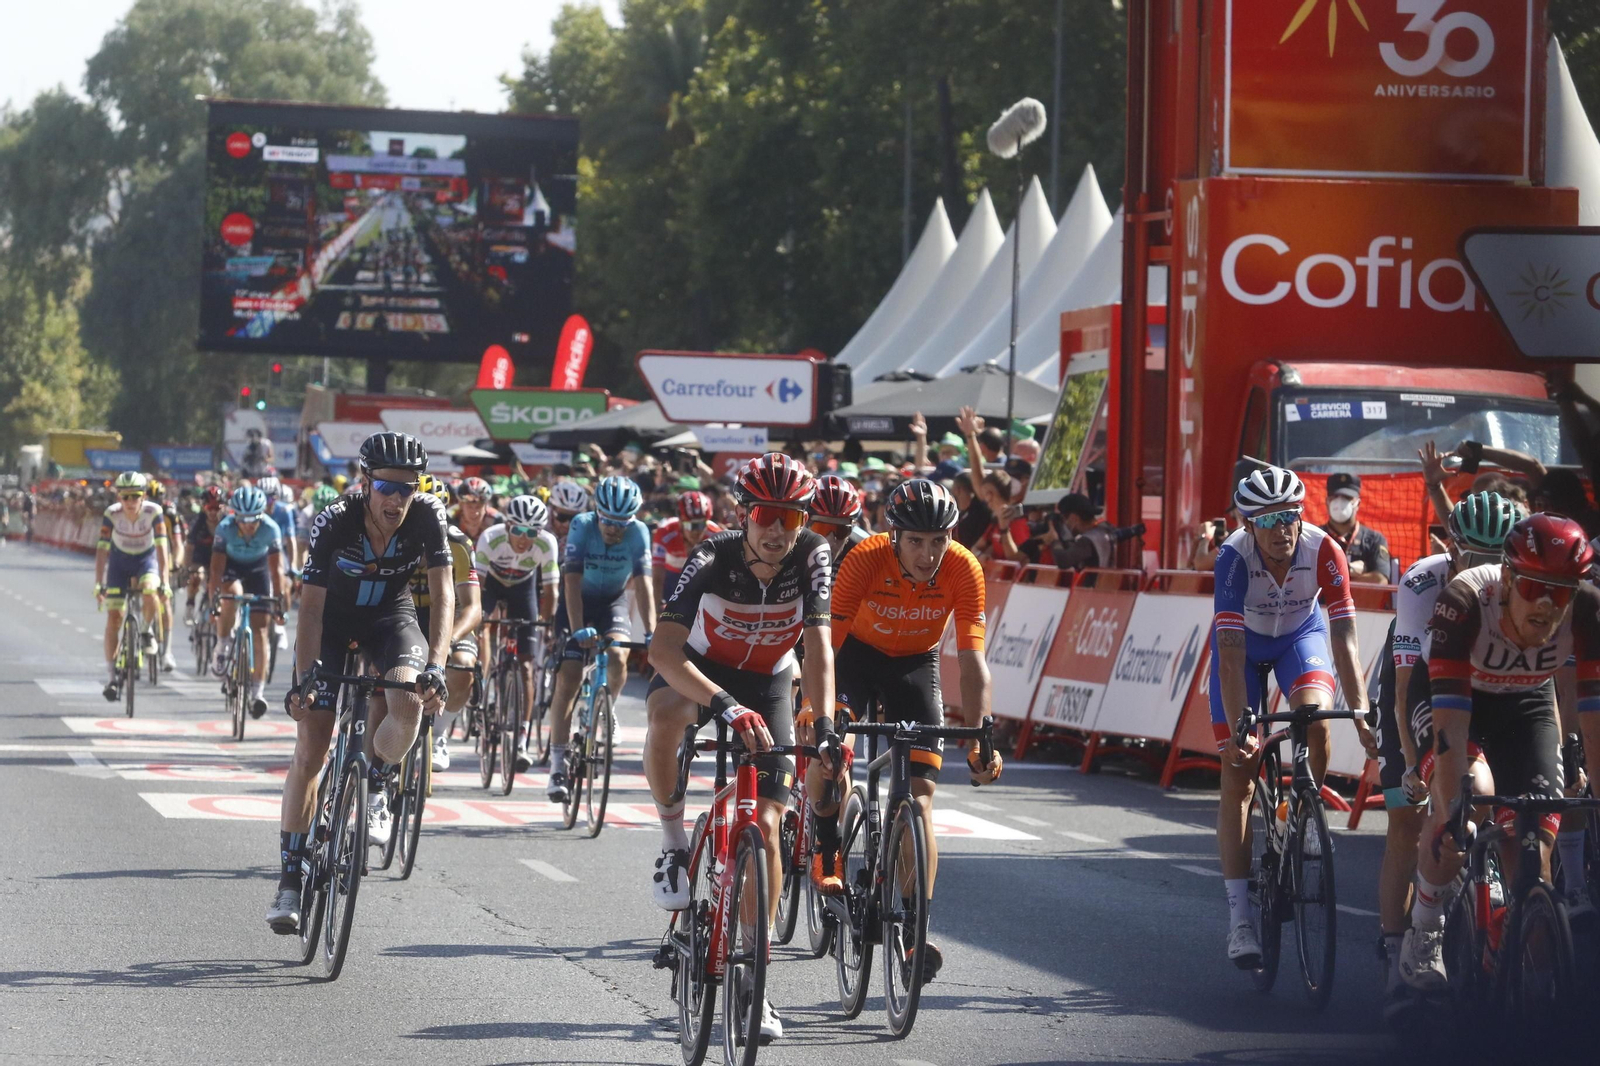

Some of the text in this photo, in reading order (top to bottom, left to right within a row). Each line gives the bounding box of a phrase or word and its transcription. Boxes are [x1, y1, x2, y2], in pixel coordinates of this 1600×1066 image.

[1379, 0, 1495, 77] 30
[1374, 84, 1495, 98] ANIVERSARIO
[1220, 234, 1490, 312] Cofid
[564, 328, 588, 391] ofidis
[661, 378, 756, 399] Carrefour
[1310, 402, 1351, 412] SERVICIO
[1310, 410, 1352, 419] CARRERA
[1365, 406, 1384, 415] 317
[380, 555, 421, 576] DSM
[668, 548, 716, 603] SOUDAL
[1225, 554, 1241, 587] Groupama
[1325, 560, 1340, 576] FDJ
[1404, 570, 1436, 589] BORA
[780, 586, 799, 599] CAPS
[867, 600, 946, 621] euskaltel
[1434, 602, 1458, 621] FAB
[722, 615, 797, 632] SOUDAL
[1076, 607, 1119, 658] Cofidis
[1115, 633, 1172, 685] Carrefour
[1483, 643, 1558, 672] UAE
